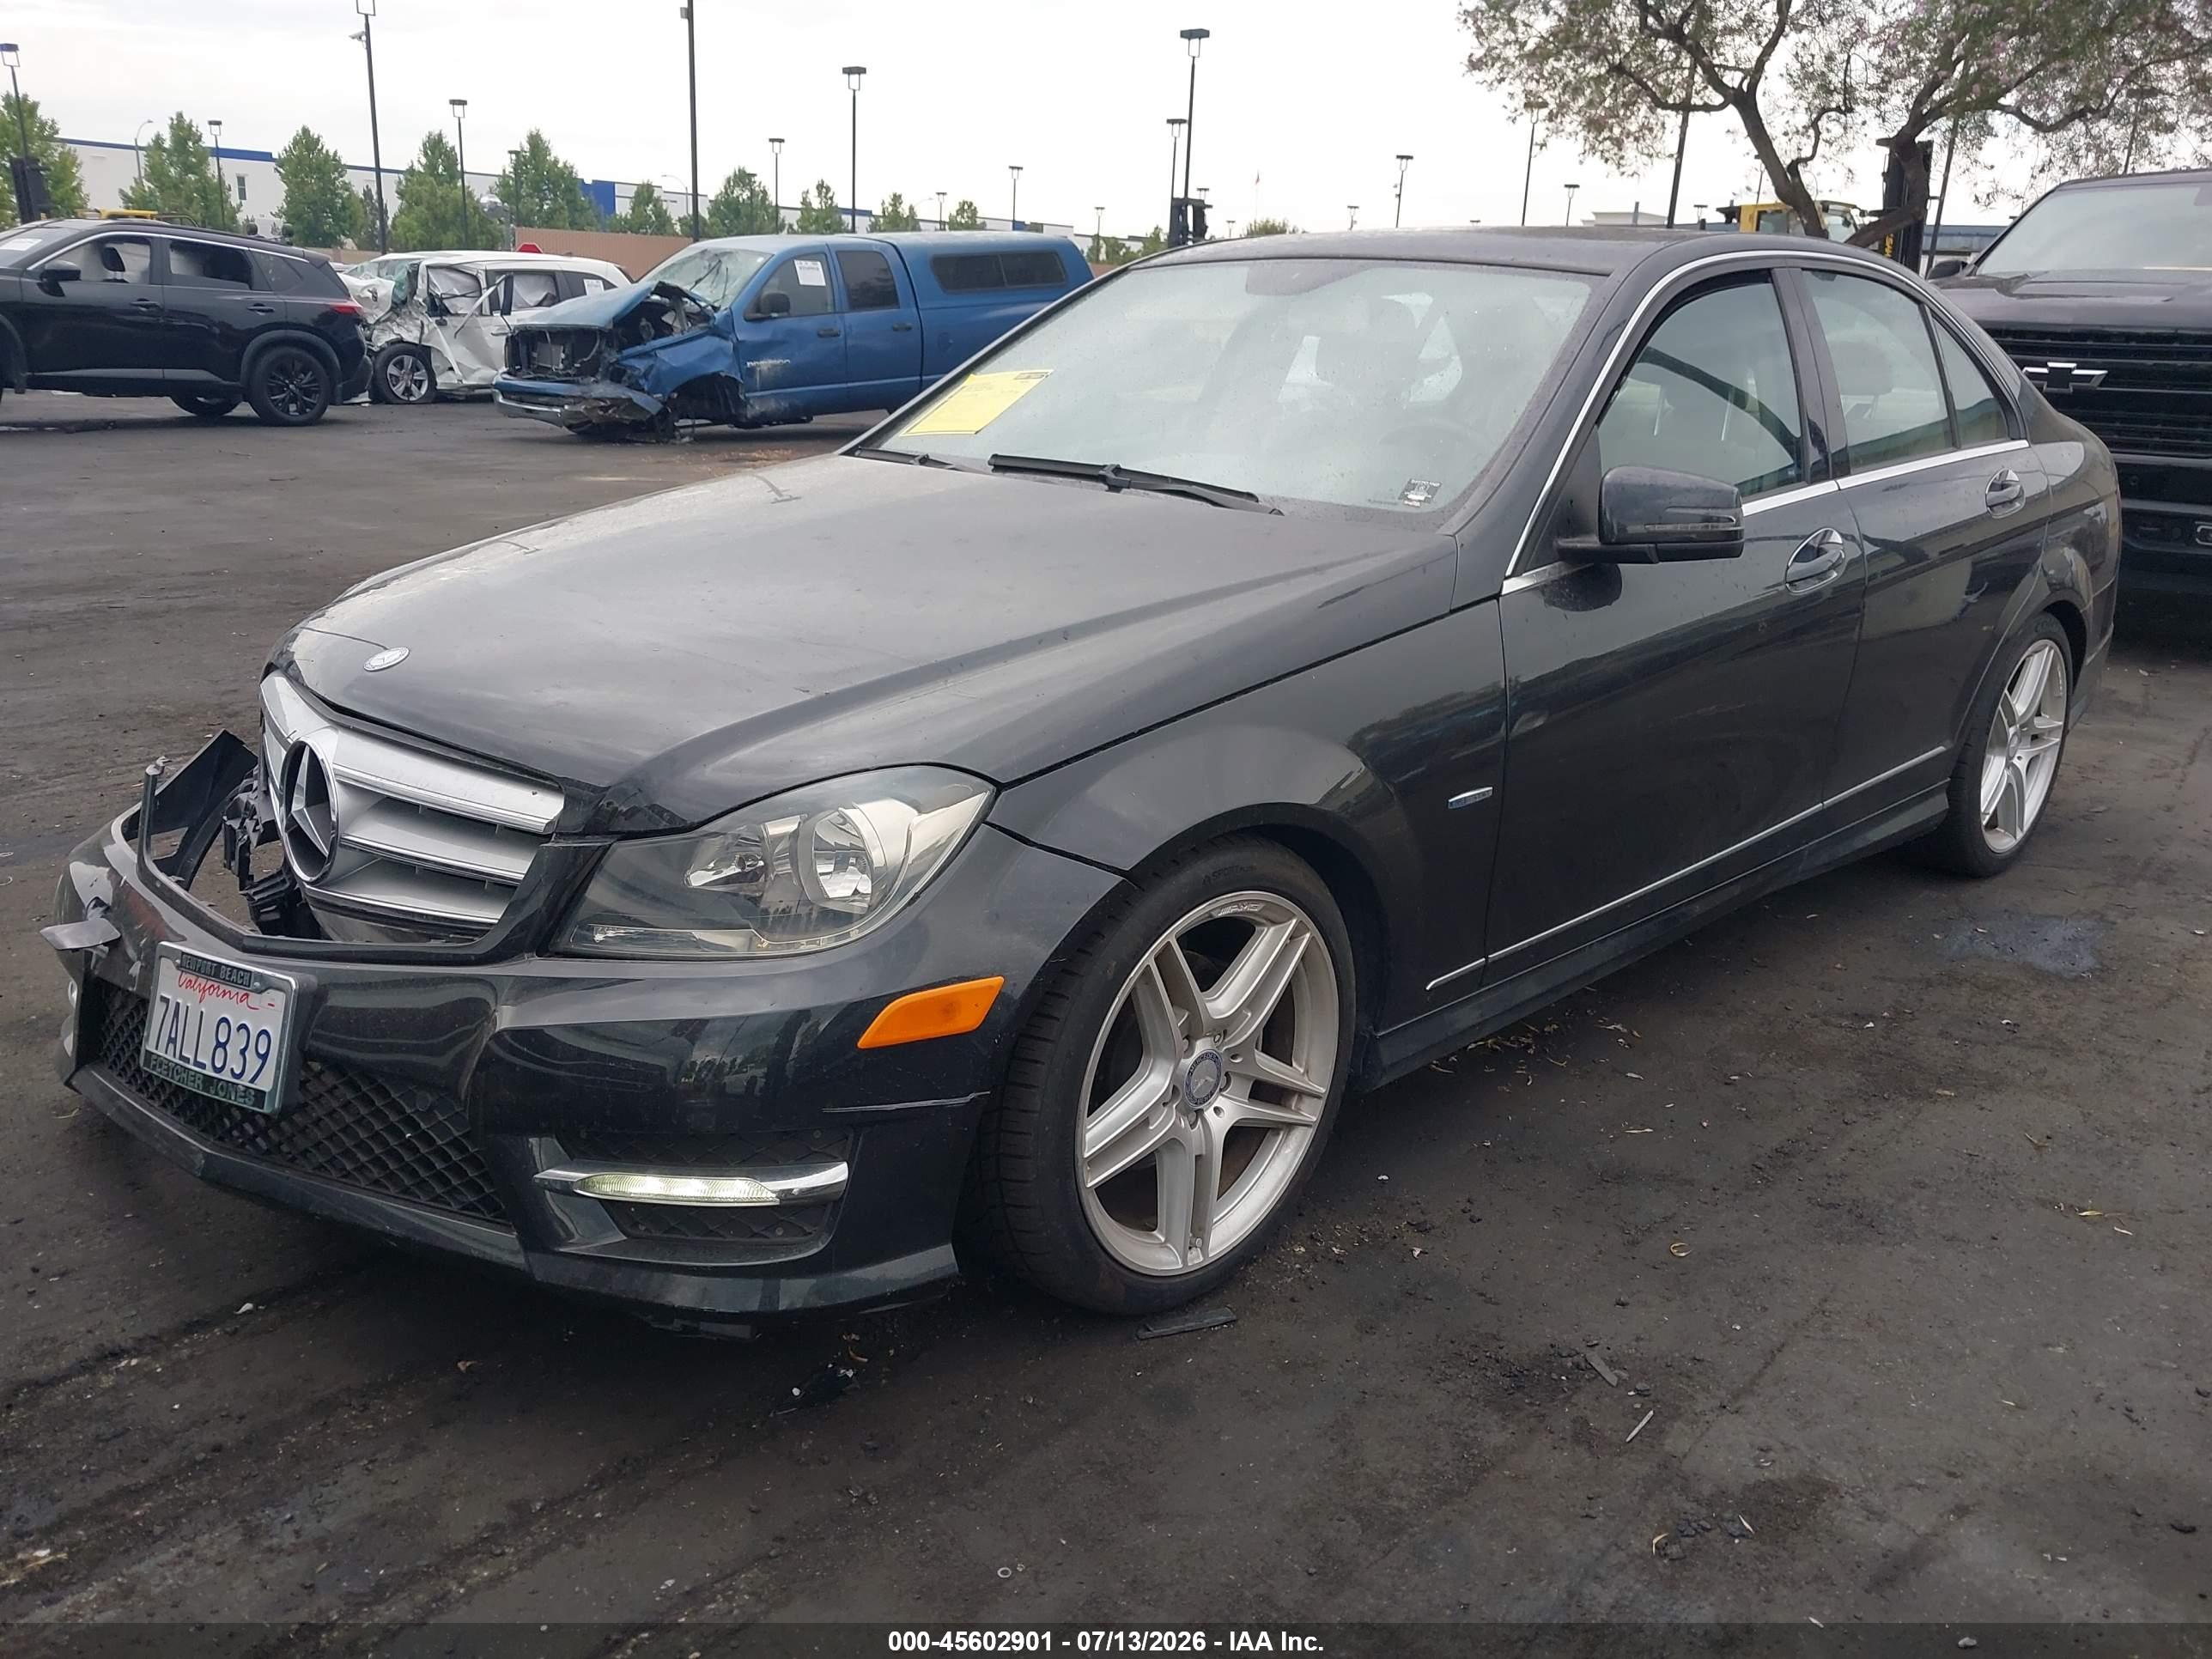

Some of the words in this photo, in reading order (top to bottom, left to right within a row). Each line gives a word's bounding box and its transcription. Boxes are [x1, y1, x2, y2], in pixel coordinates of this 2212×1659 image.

[178, 972, 260, 1010] California
[182, 954, 216, 977] NEWPORT
[220, 963, 251, 988] BEACH
[155, 995, 271, 1084] 7ALL839
[149, 1056, 204, 1090] FLETCHER
[210, 1079, 255, 1105] JONES
